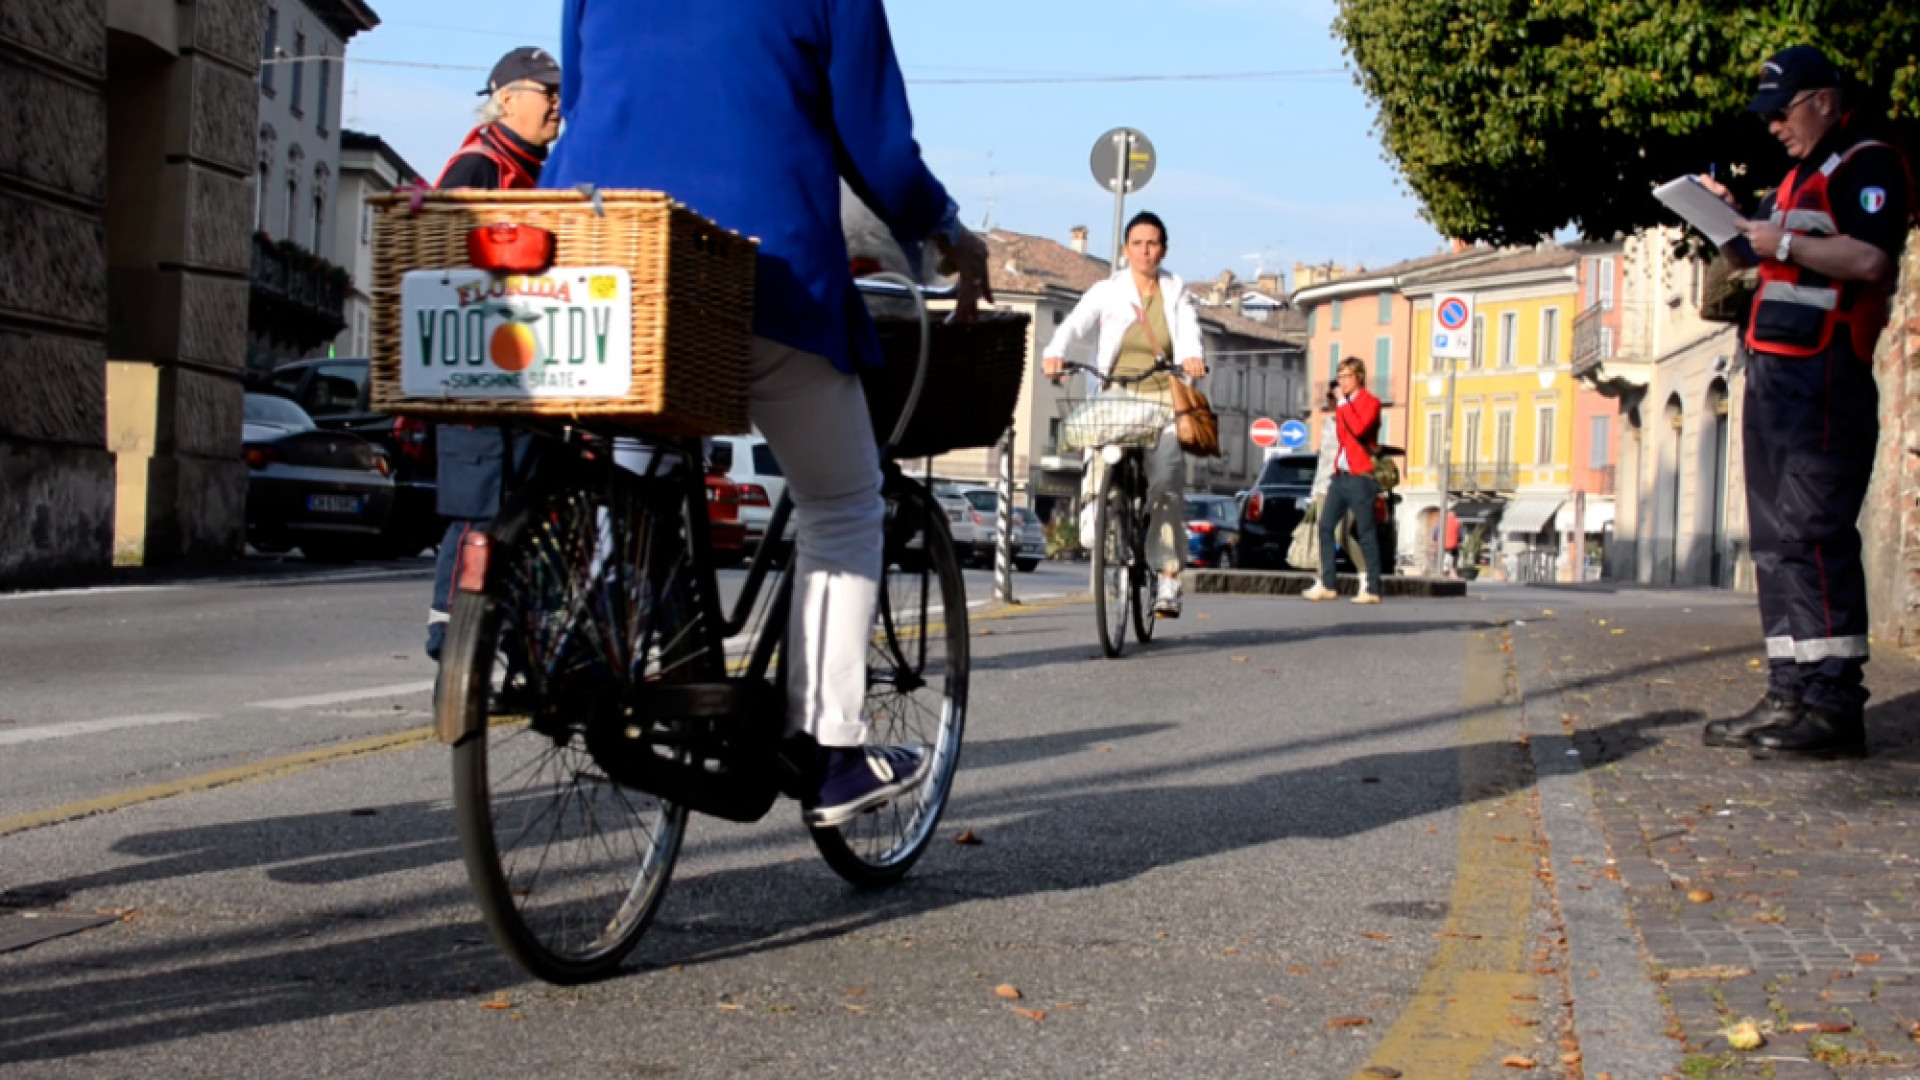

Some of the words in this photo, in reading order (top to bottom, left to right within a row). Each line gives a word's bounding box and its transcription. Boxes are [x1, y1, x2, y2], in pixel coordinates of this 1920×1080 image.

[456, 274, 571, 307] FLORIDA
[450, 371, 521, 388] SUNSHINE
[529, 371, 574, 388] STATE
